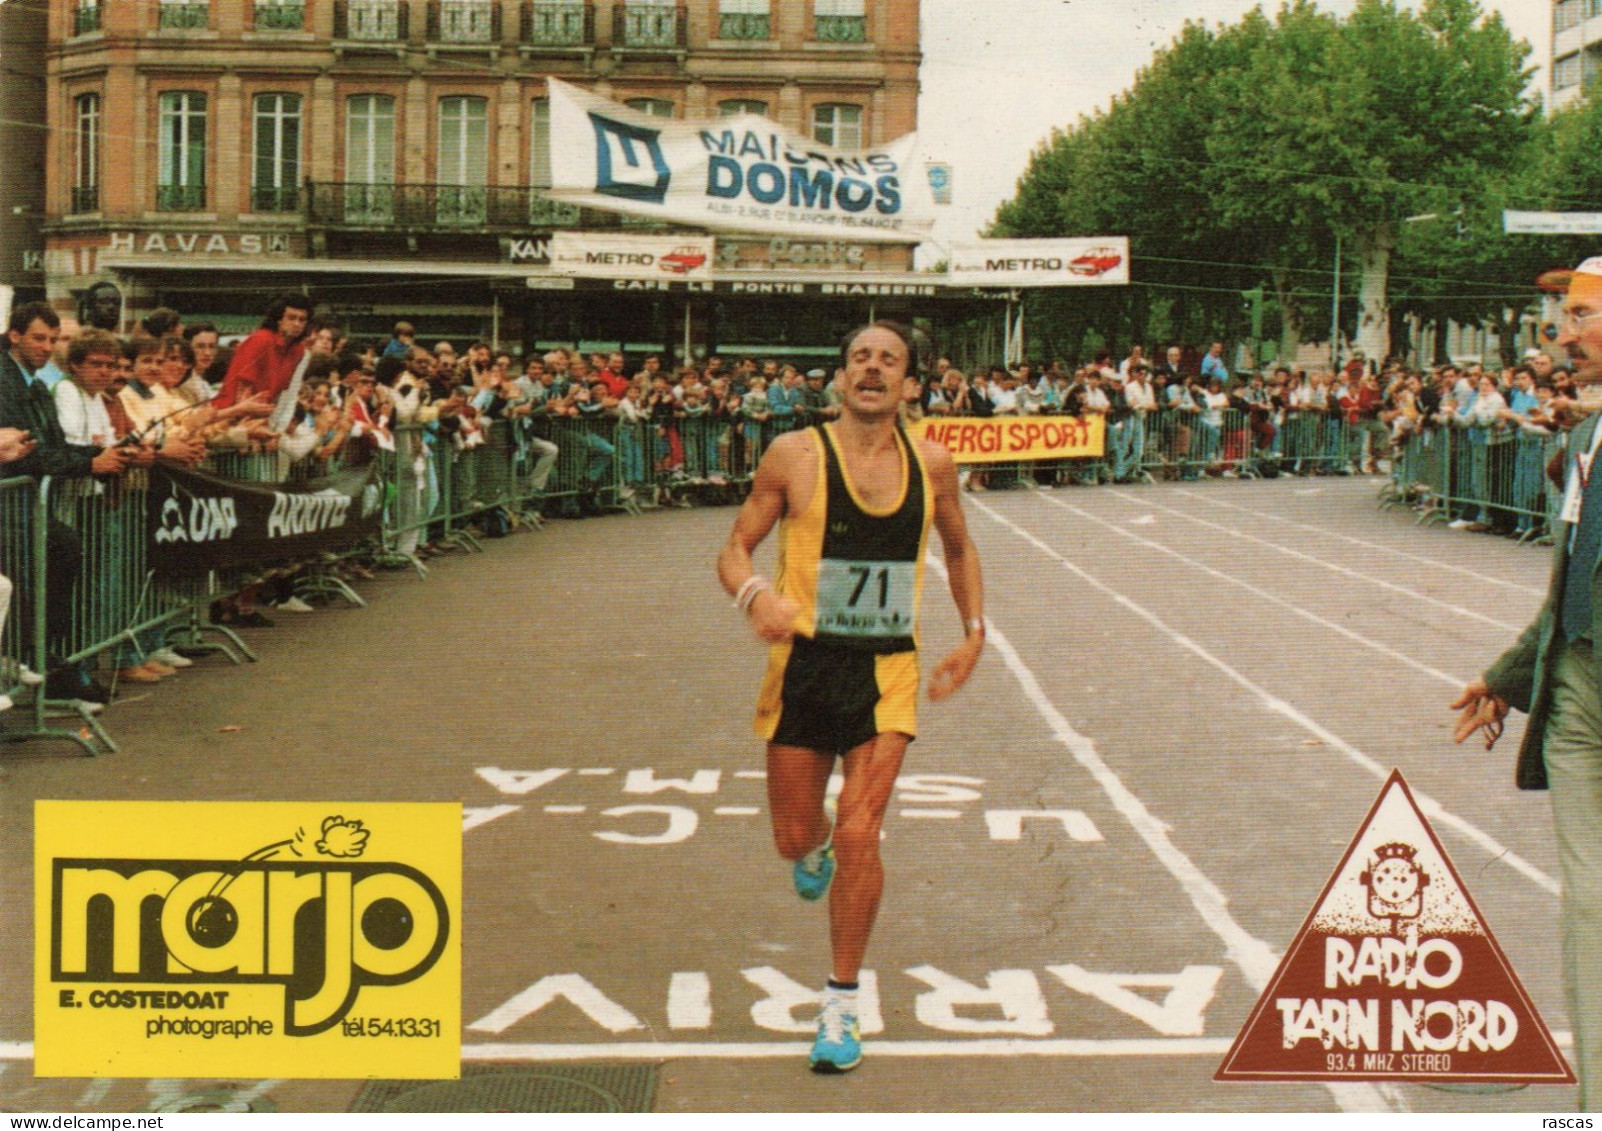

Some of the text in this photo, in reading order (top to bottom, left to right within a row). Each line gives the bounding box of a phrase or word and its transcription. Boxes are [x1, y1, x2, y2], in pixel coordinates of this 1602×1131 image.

[706, 154, 901, 214] DOMOS
[111, 232, 263, 253] HAVAS
[586, 251, 655, 266] METRO
[986, 257, 1063, 272] METRO
[687, 281, 714, 292] LE
[733, 282, 804, 294] PONTIE
[821, 284, 937, 297] BRASSERIE
[1008, 420, 1091, 452] SPORT
[847, 566, 889, 609] 71
